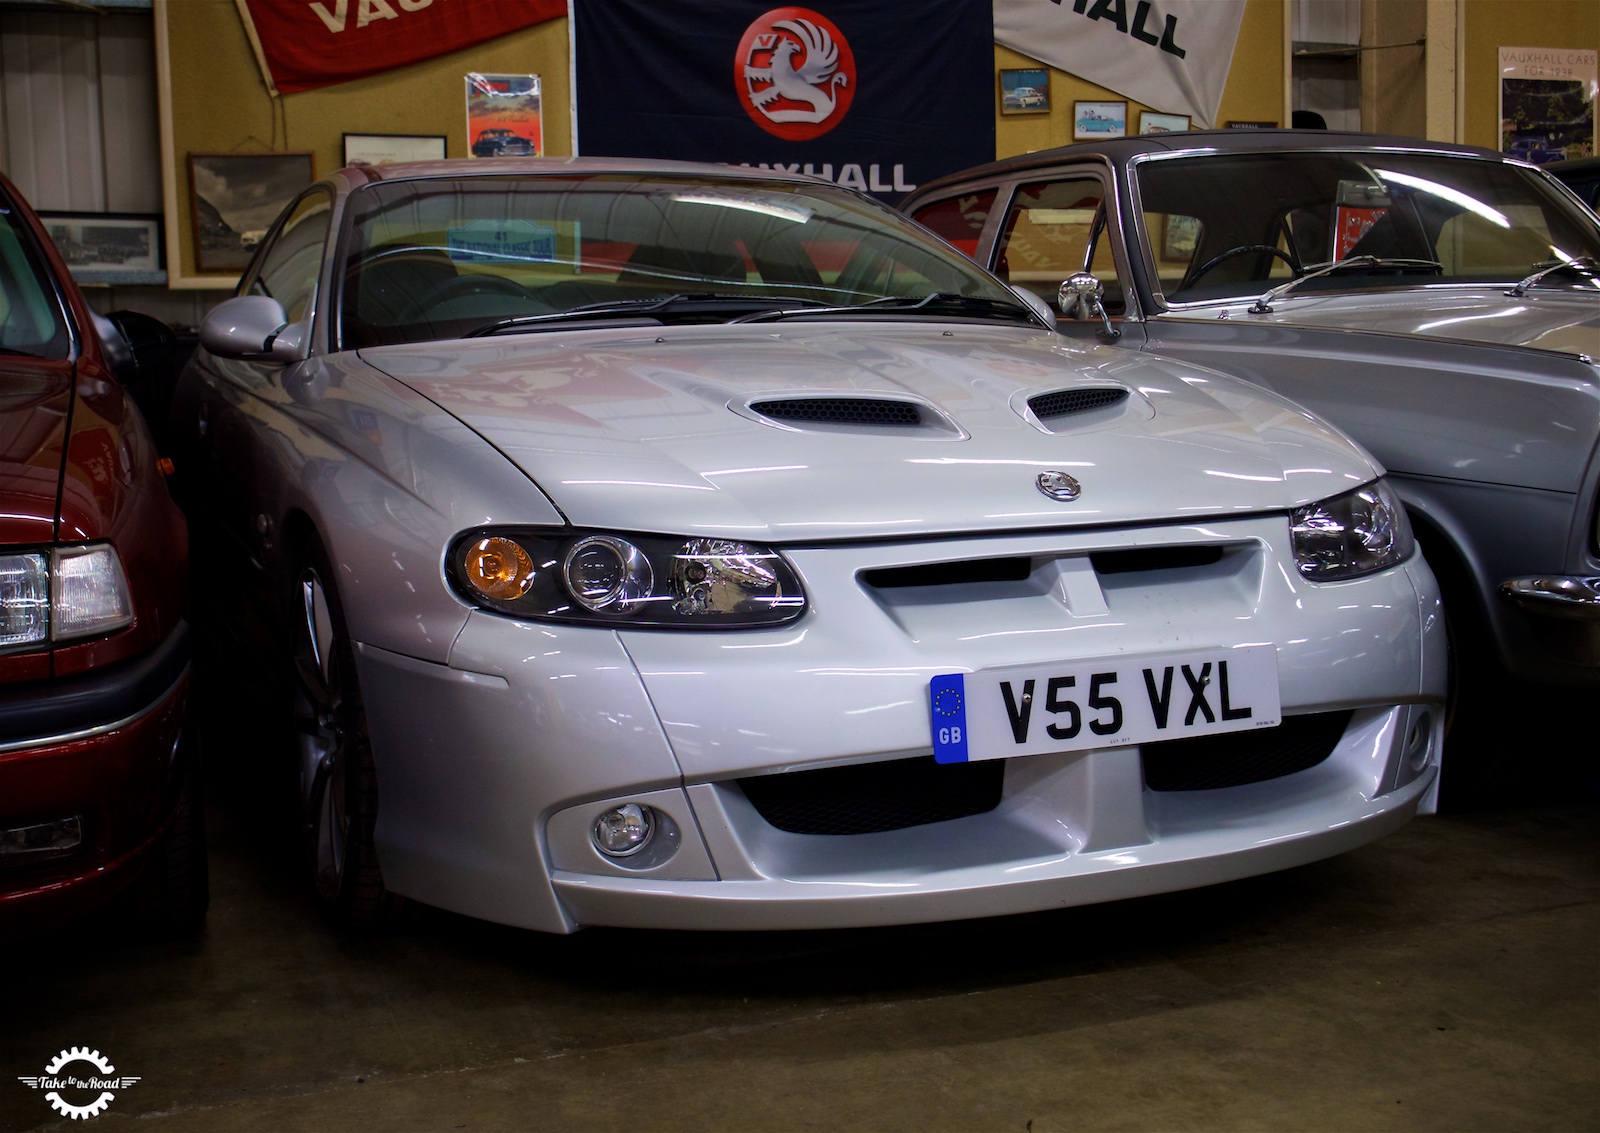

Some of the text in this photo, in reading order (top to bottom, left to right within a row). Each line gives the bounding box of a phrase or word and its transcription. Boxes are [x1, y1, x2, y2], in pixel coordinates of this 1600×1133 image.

[1501, 52, 1596, 66] VAUXHALL CARS
[1524, 65, 1573, 77] FOR 1938
[495, 230, 508, 242] 41
[999, 660, 1253, 744] V55 VXL
[938, 726, 962, 745] GB
